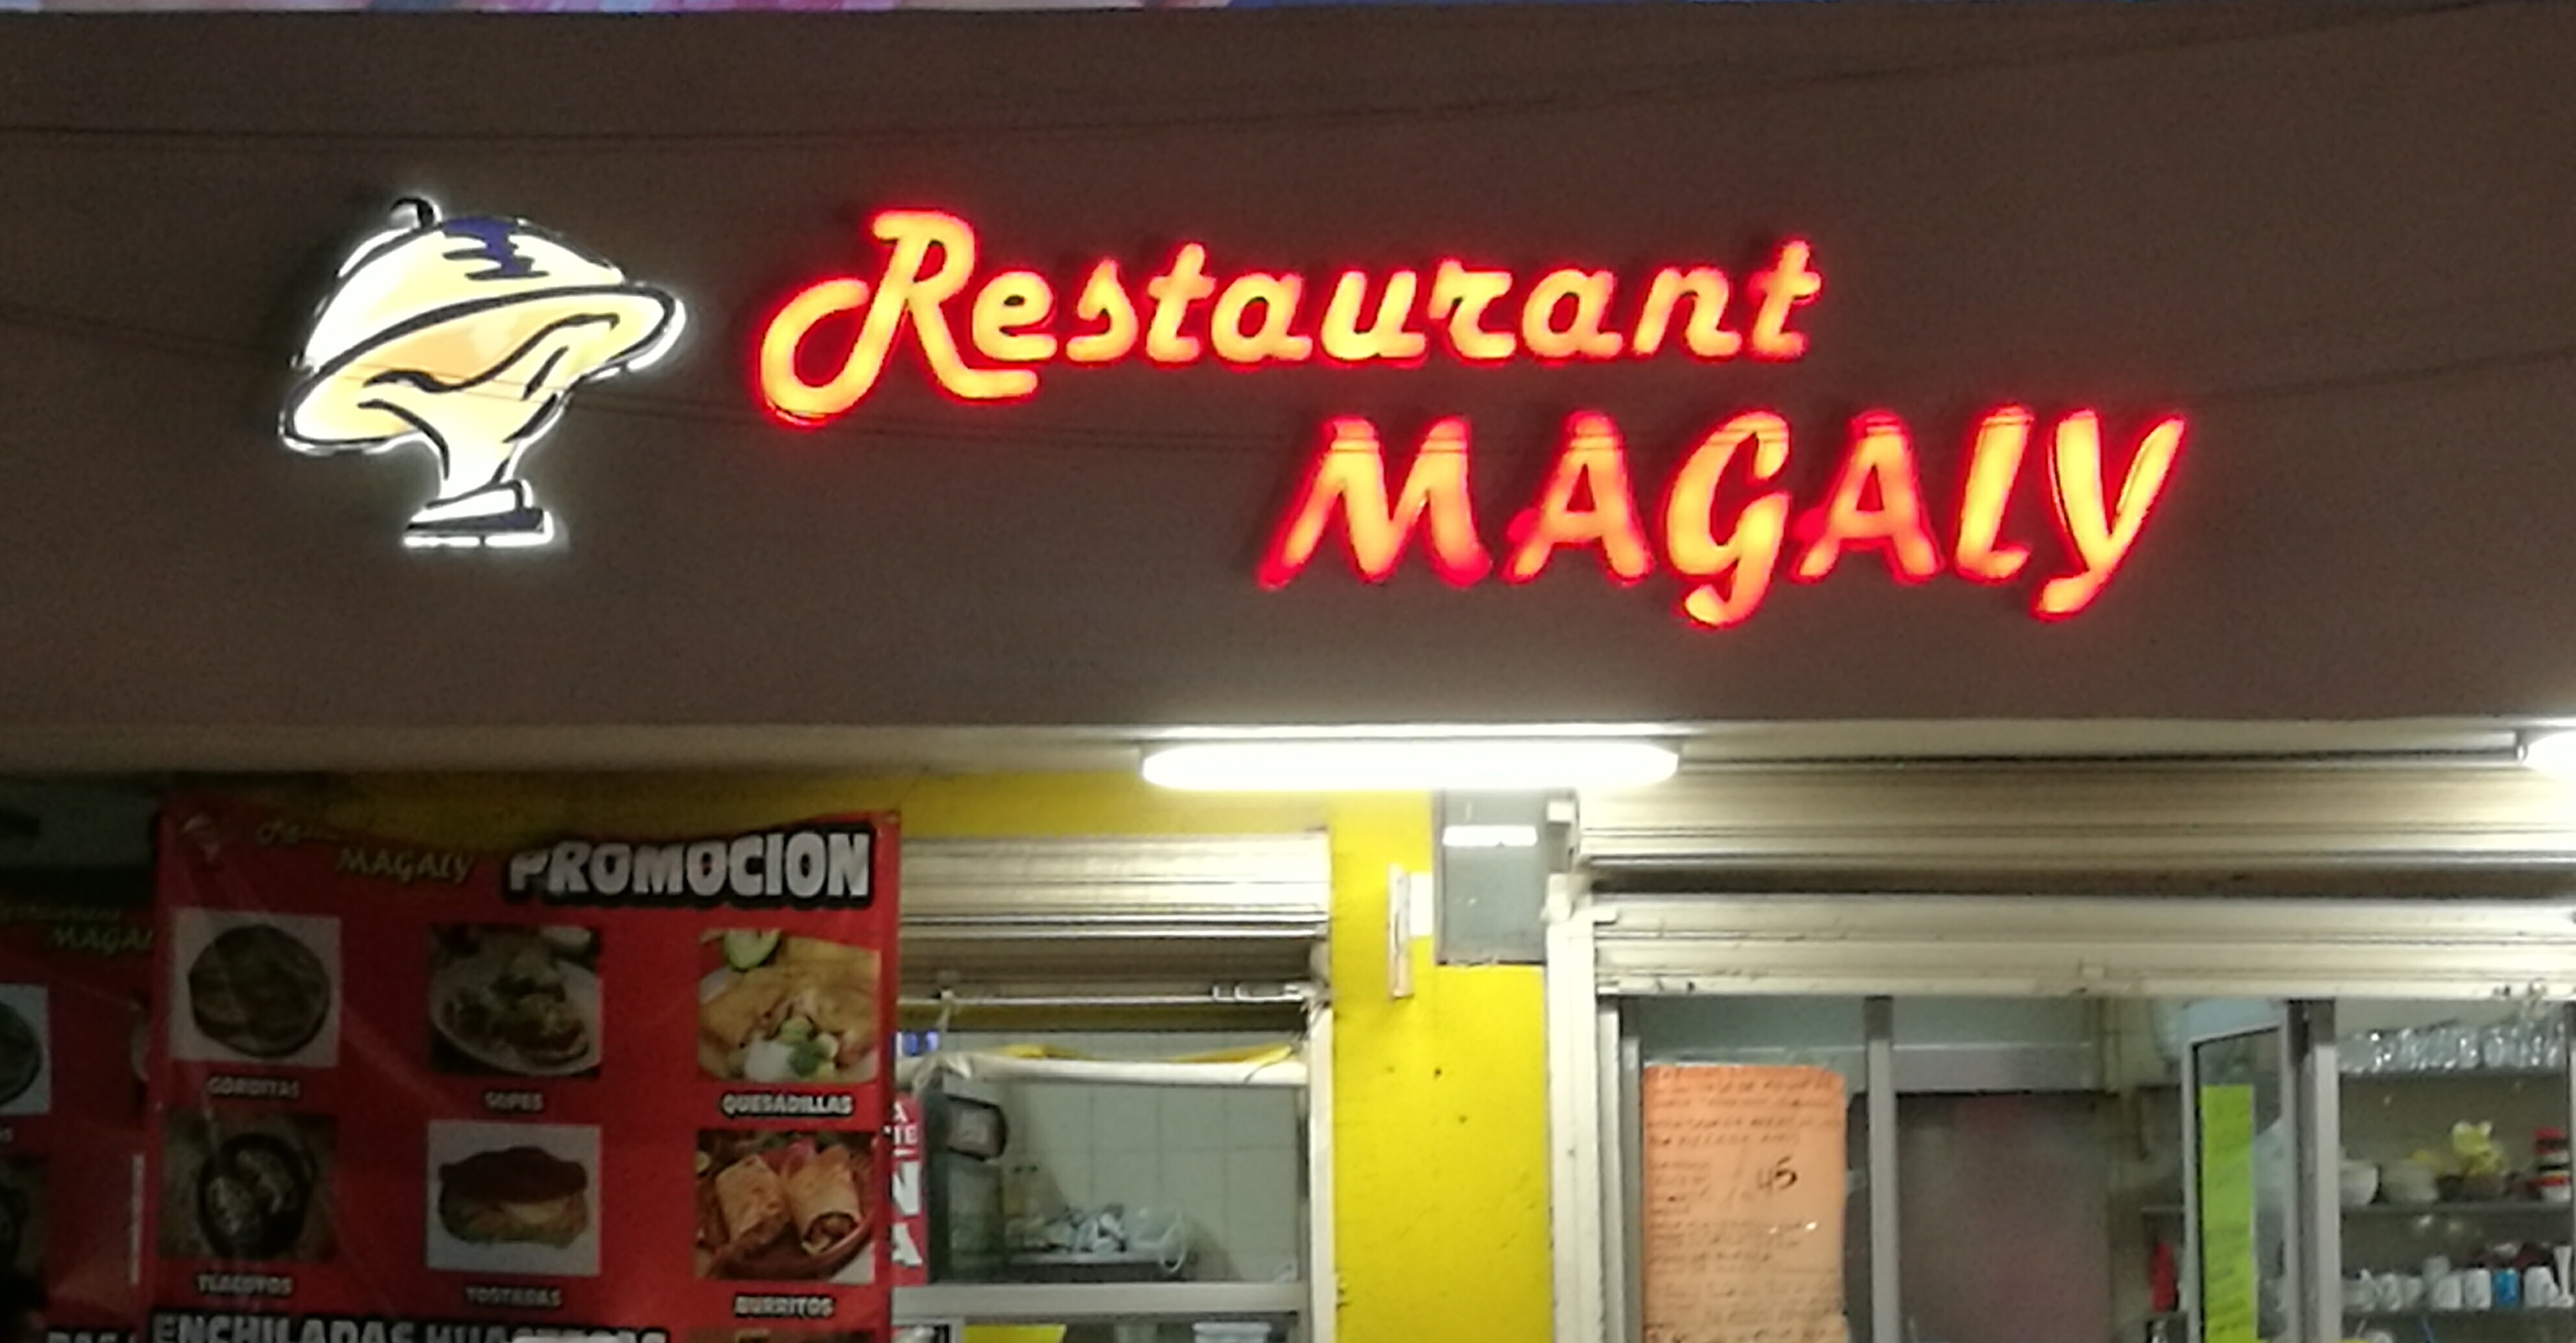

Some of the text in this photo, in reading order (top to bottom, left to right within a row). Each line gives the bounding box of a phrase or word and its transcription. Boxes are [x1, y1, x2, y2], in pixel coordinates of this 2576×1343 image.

[757, 207, 1826, 429] Restaurant
[1256, 403, 2189, 628] MAGALY
[336, 847, 475, 885] MAGALY
[508, 832, 870, 898] PROMOCION
[47, 924, 155, 956] MAGAL
[206, 1075, 301, 1099] GORDITAS
[484, 1091, 543, 1112] SOPES
[721, 1092, 854, 1116] QUESADILLAS
[465, 1286, 564, 1308] TOSTADAS
[734, 1295, 834, 1318] BURRITOS
[152, 1312, 415, 1343] ENCHILADAS
